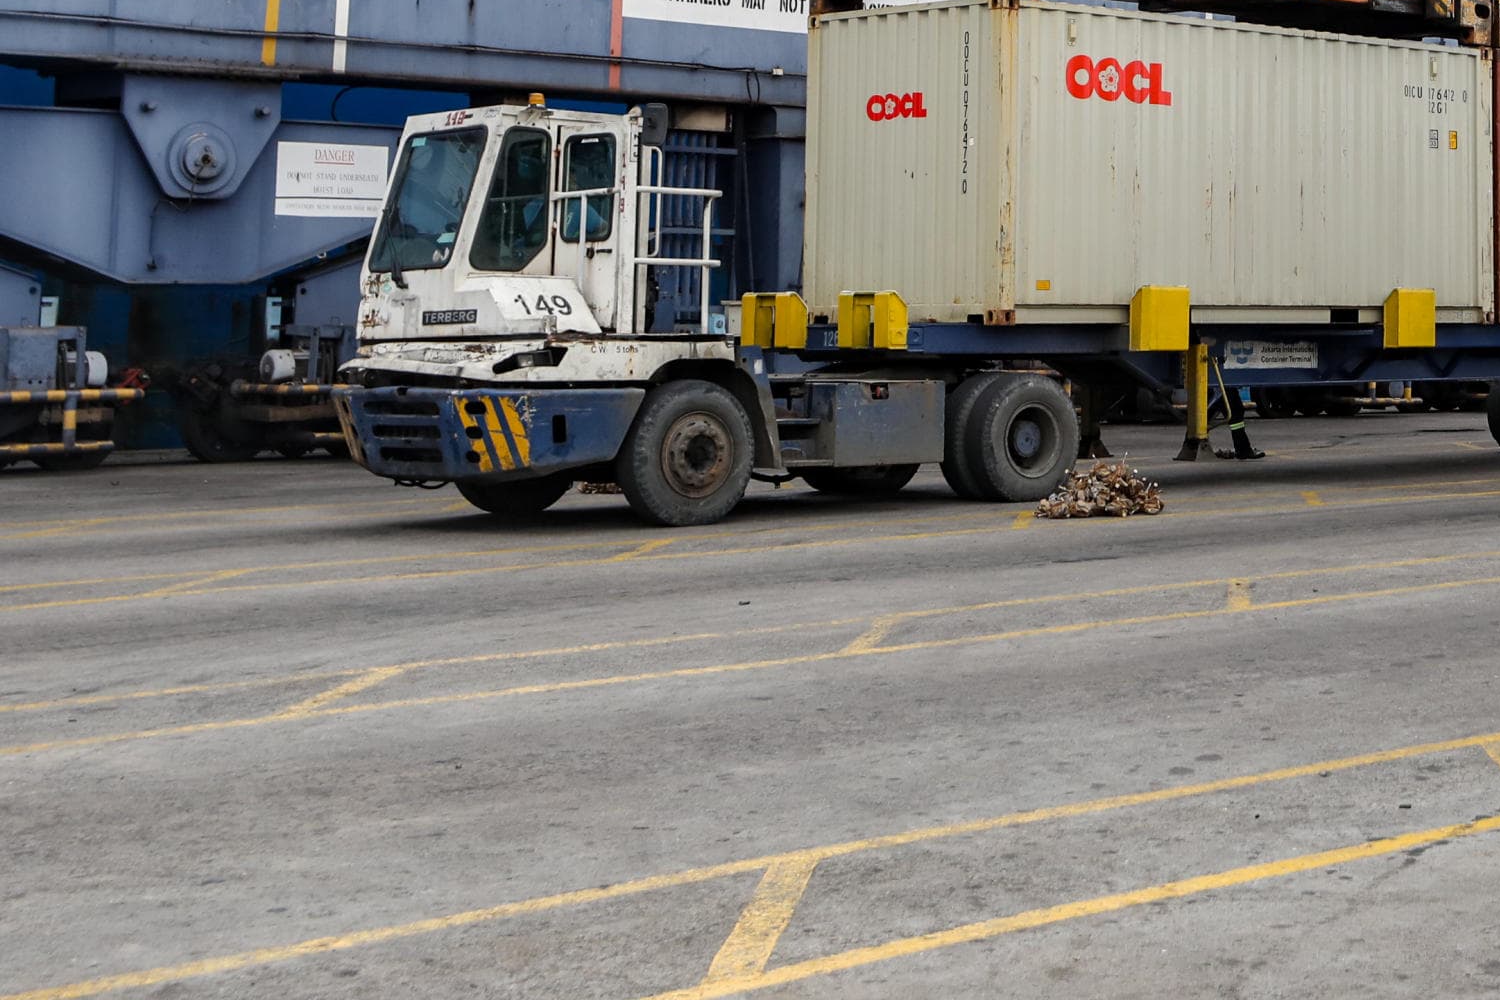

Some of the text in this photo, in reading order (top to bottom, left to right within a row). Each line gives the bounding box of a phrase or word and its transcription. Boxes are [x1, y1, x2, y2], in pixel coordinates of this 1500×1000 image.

[1065, 54, 1172, 106] OOCL
[866, 92, 927, 122] OOCL
[423, 311, 476, 325] TERBERG
[514, 294, 572, 316] 149
